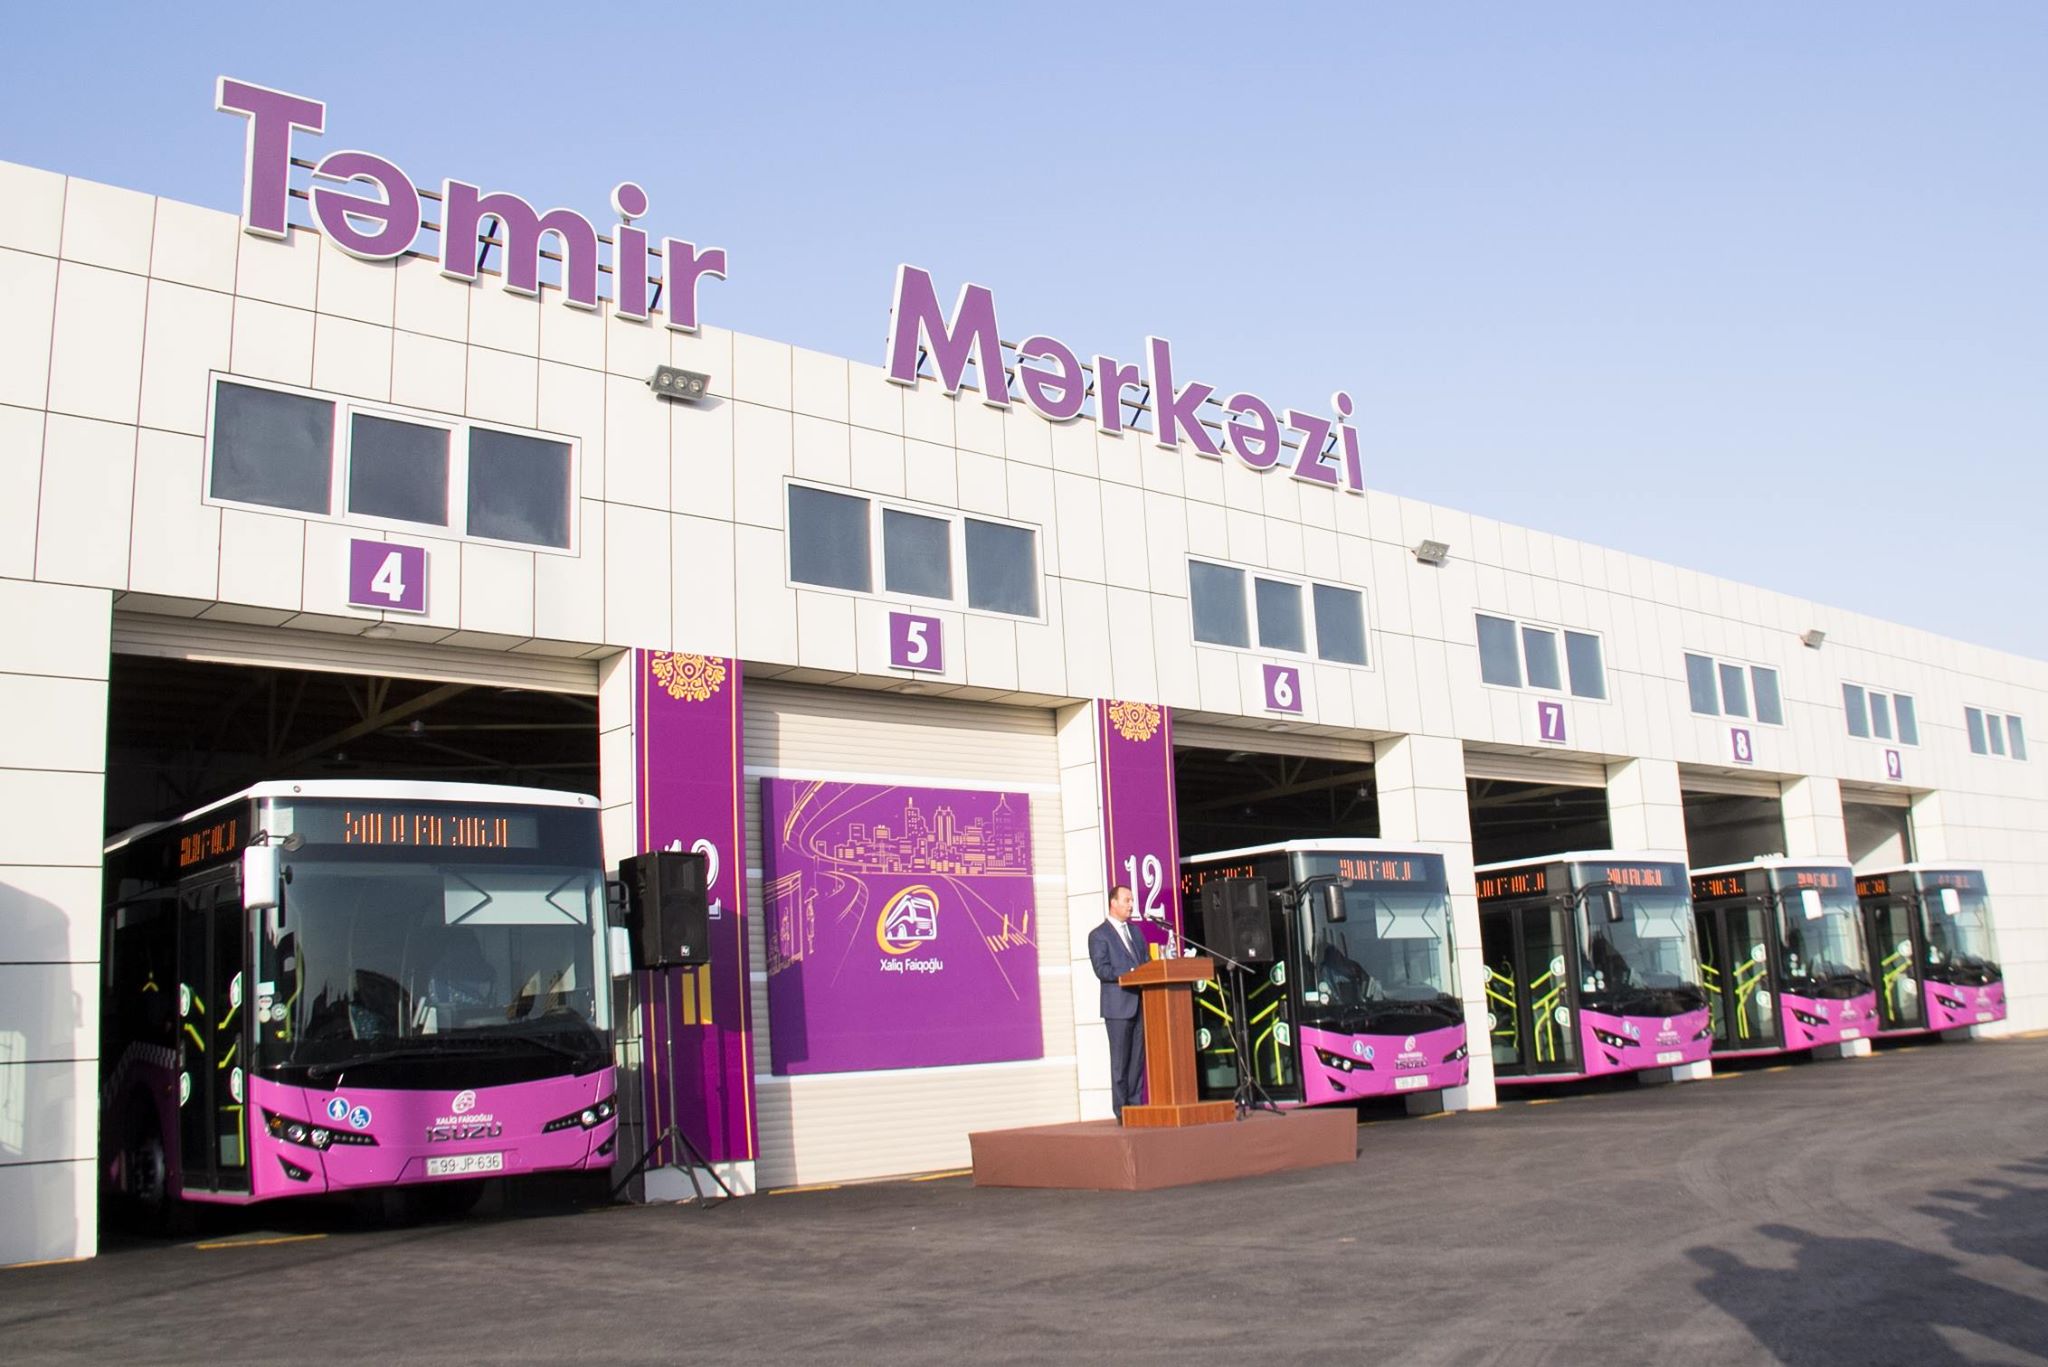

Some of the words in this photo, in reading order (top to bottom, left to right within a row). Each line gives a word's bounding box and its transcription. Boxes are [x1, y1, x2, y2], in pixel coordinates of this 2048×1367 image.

[215, 75, 728, 332] Təmir
[885, 263, 1364, 495] Mərkəzi
[370, 551, 406, 602] 4
[907, 620, 928, 664] 5
[1273, 671, 1293, 707] 6
[1545, 706, 1559, 737] 7
[1736, 731, 1749, 759] 8
[1887, 751, 1898, 776] 9
[1124, 854, 1166, 922] 12
[880, 958, 903, 973] Xaliq
[905, 958, 943, 973] Faiqoğlu
[426, 1121, 502, 1142] ISUZU
